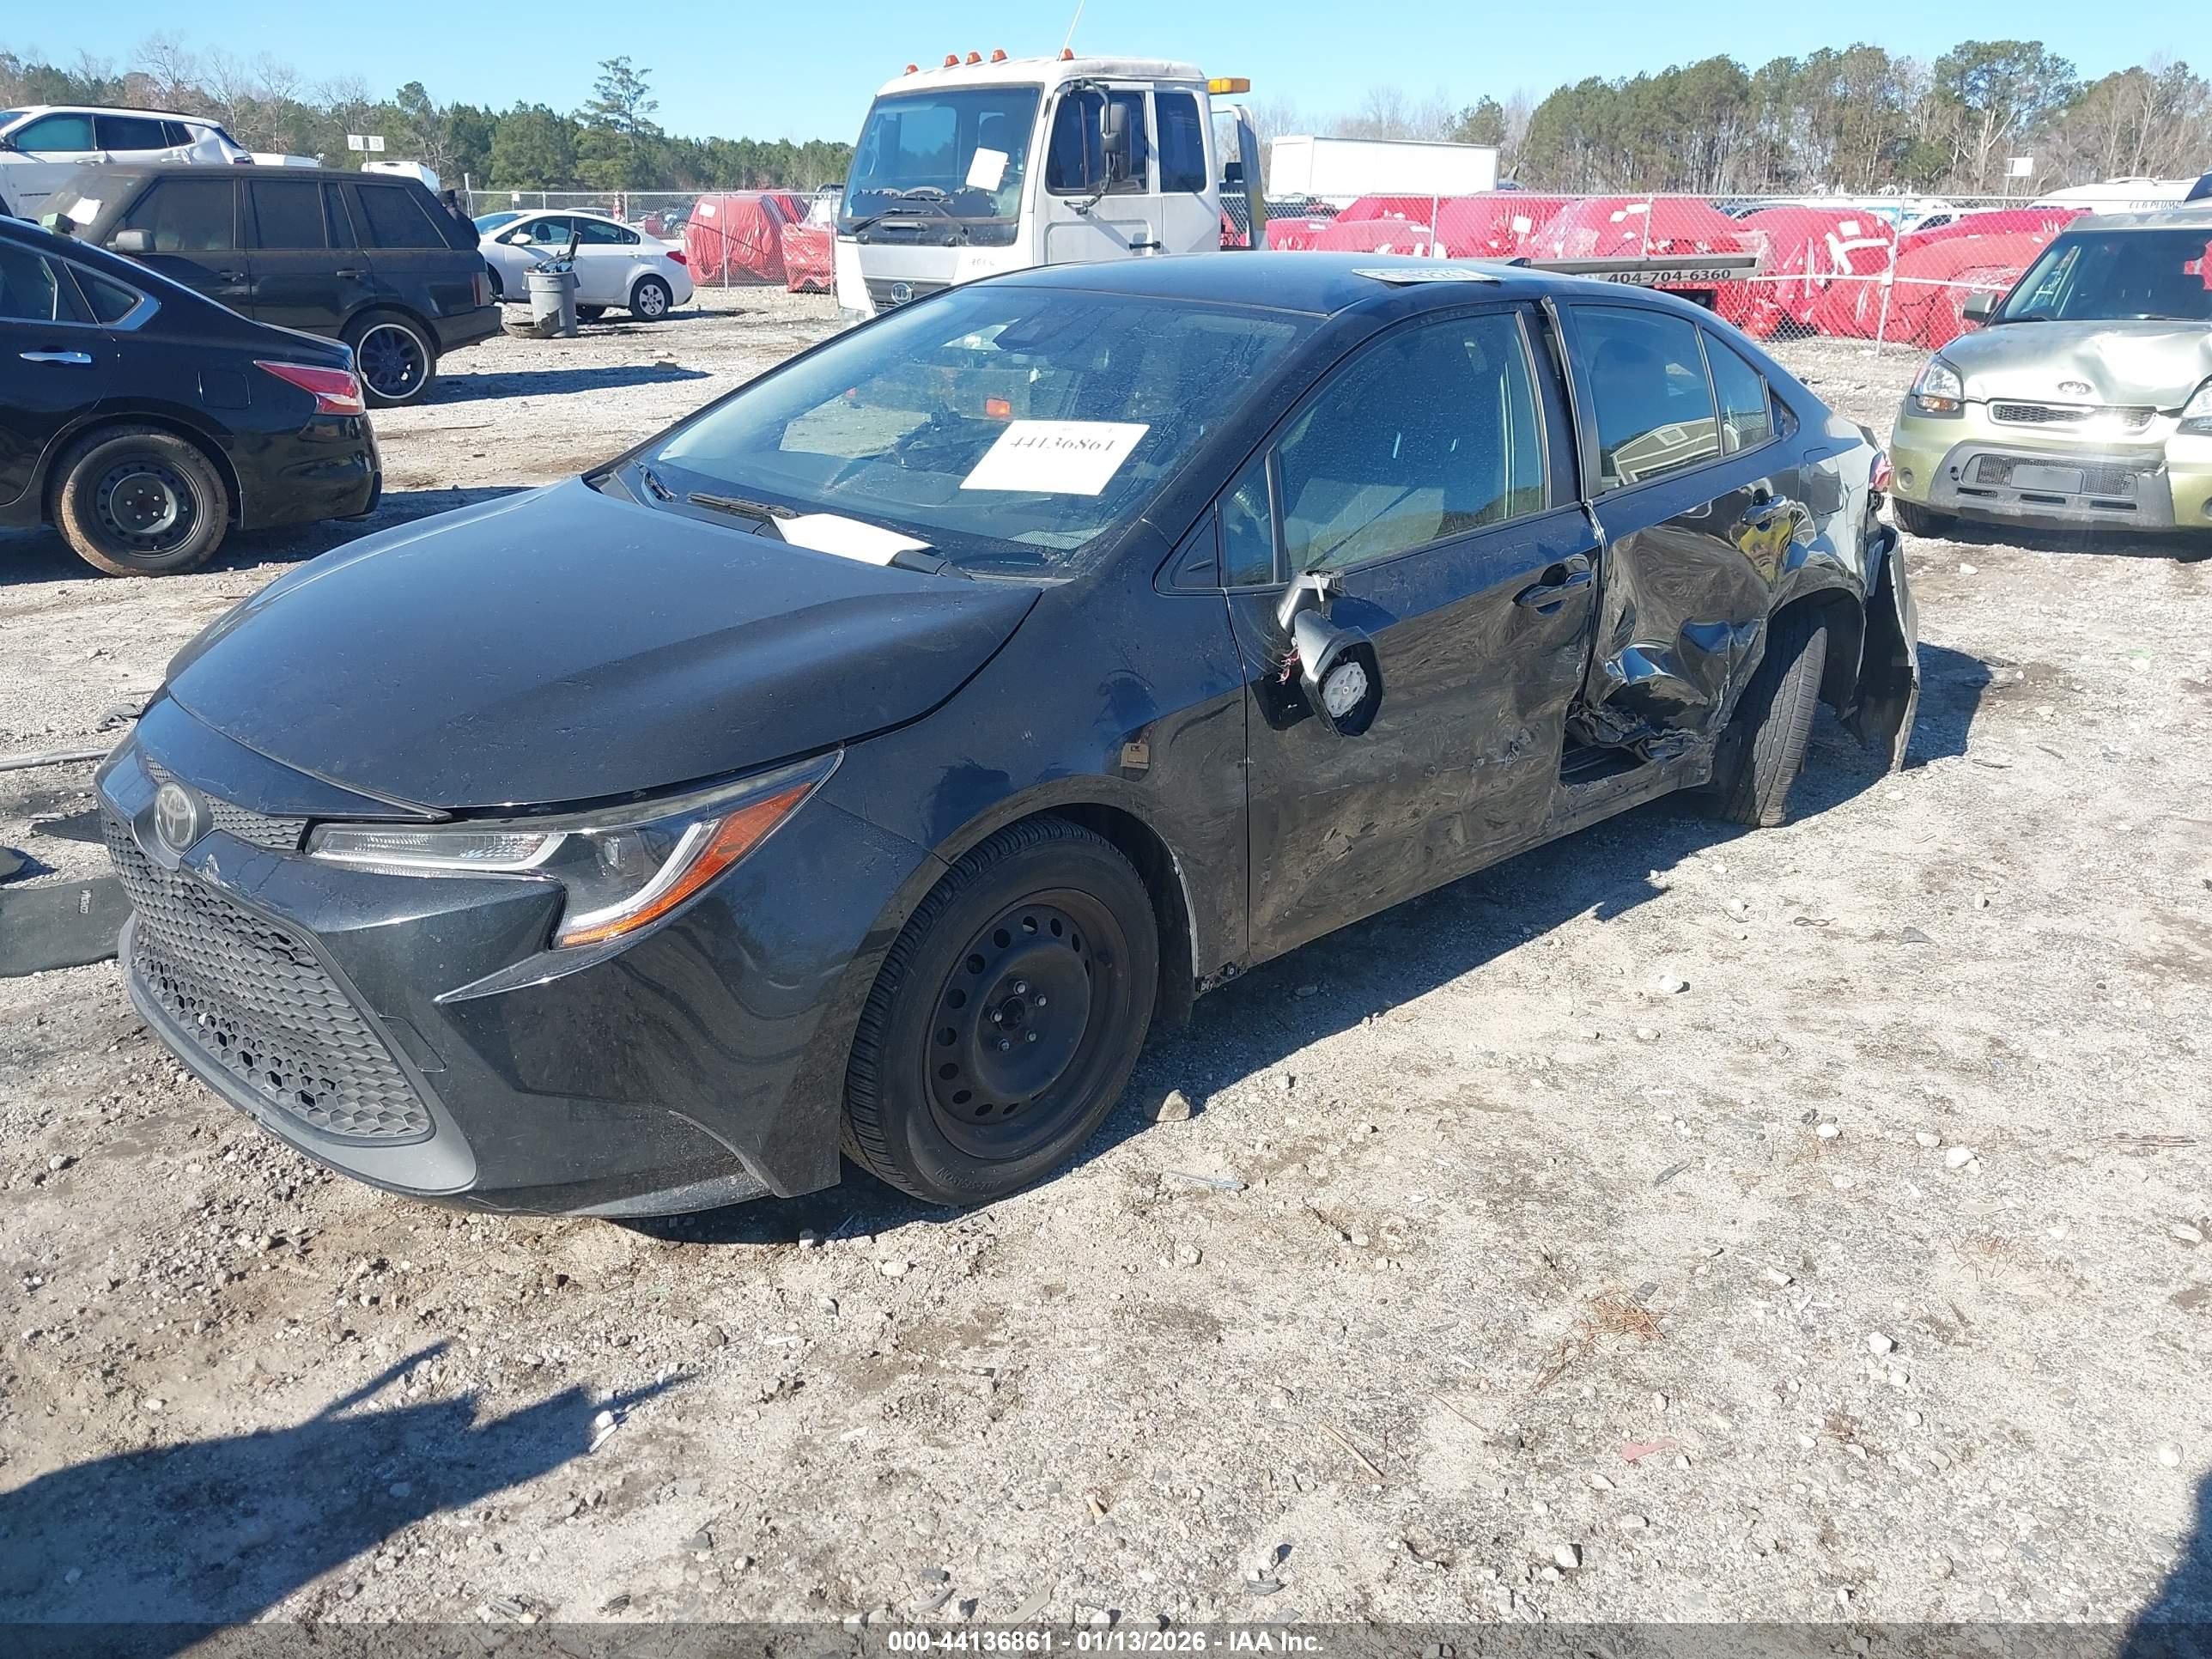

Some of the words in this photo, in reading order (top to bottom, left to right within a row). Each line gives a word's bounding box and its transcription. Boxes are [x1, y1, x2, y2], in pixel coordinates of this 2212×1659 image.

[350, 137, 361, 149] A
[372, 137, 381, 149] B
[1607, 269, 1731, 284] 404-704-6360
[1009, 435, 1115, 452] 44136861
